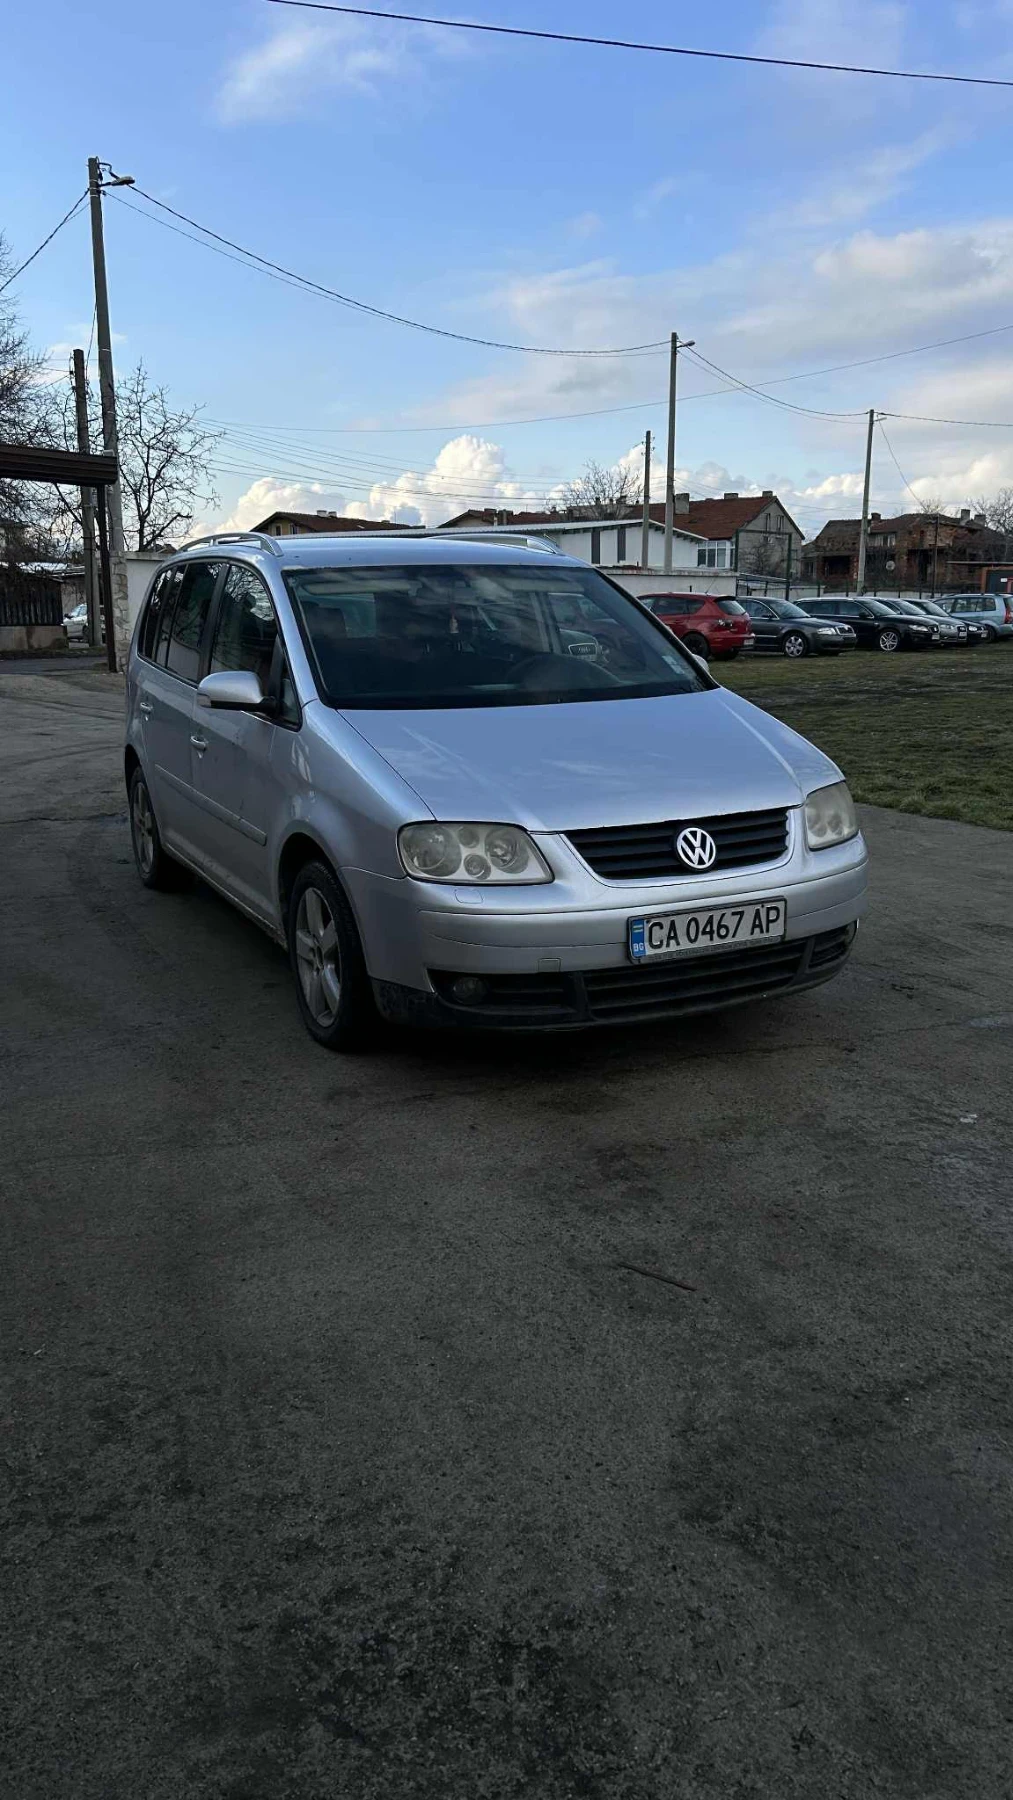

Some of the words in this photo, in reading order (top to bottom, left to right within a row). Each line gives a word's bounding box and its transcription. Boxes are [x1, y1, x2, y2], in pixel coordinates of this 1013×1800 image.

[648, 920, 680, 949] CA
[686, 910, 745, 943] 0467
[750, 905, 780, 935] AP
[633, 942, 645, 952] BG
